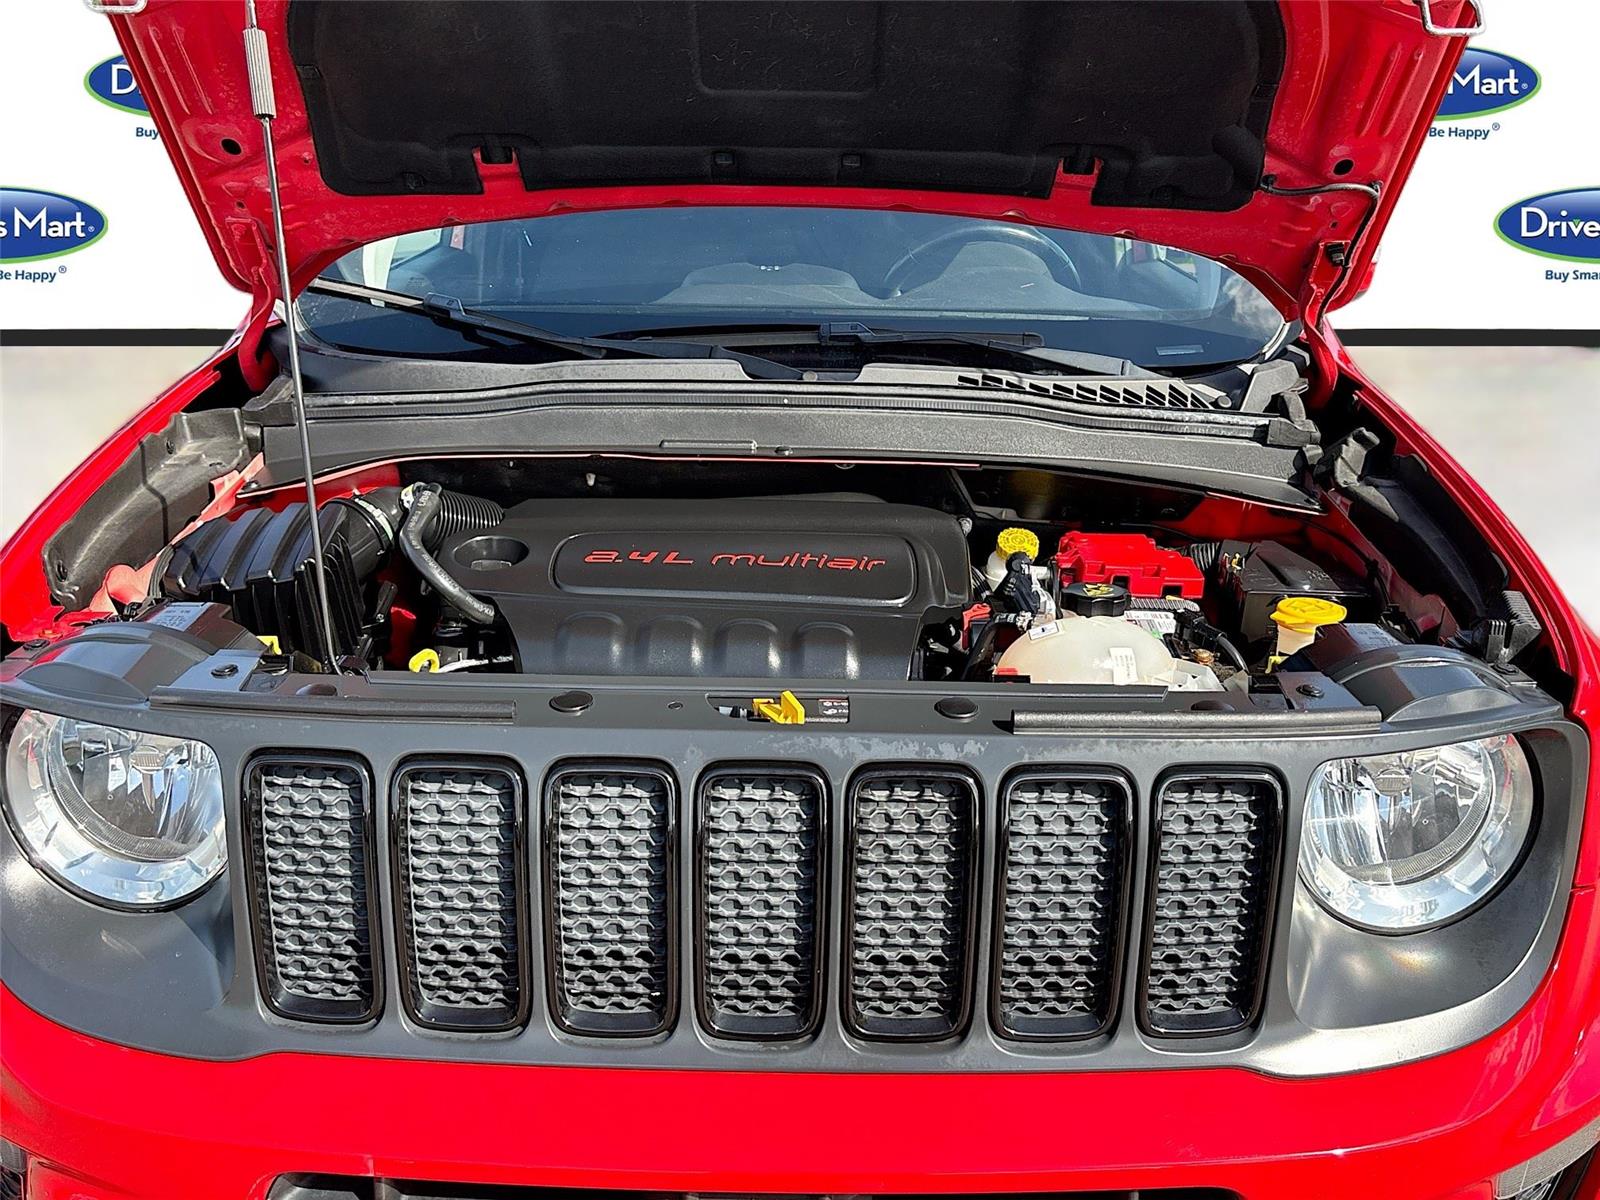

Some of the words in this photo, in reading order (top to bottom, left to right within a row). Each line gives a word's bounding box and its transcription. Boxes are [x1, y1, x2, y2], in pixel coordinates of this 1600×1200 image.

[1447, 63, 1520, 94] Mart
[135, 127, 159, 140] Buy
[1429, 127, 1445, 137] Be
[1448, 127, 1490, 140] Happy
[14, 206, 86, 237] Mart
[15, 270, 57, 283] Happy
[1545, 270, 1570, 283] Buy
[711, 552, 886, 571] multiair
